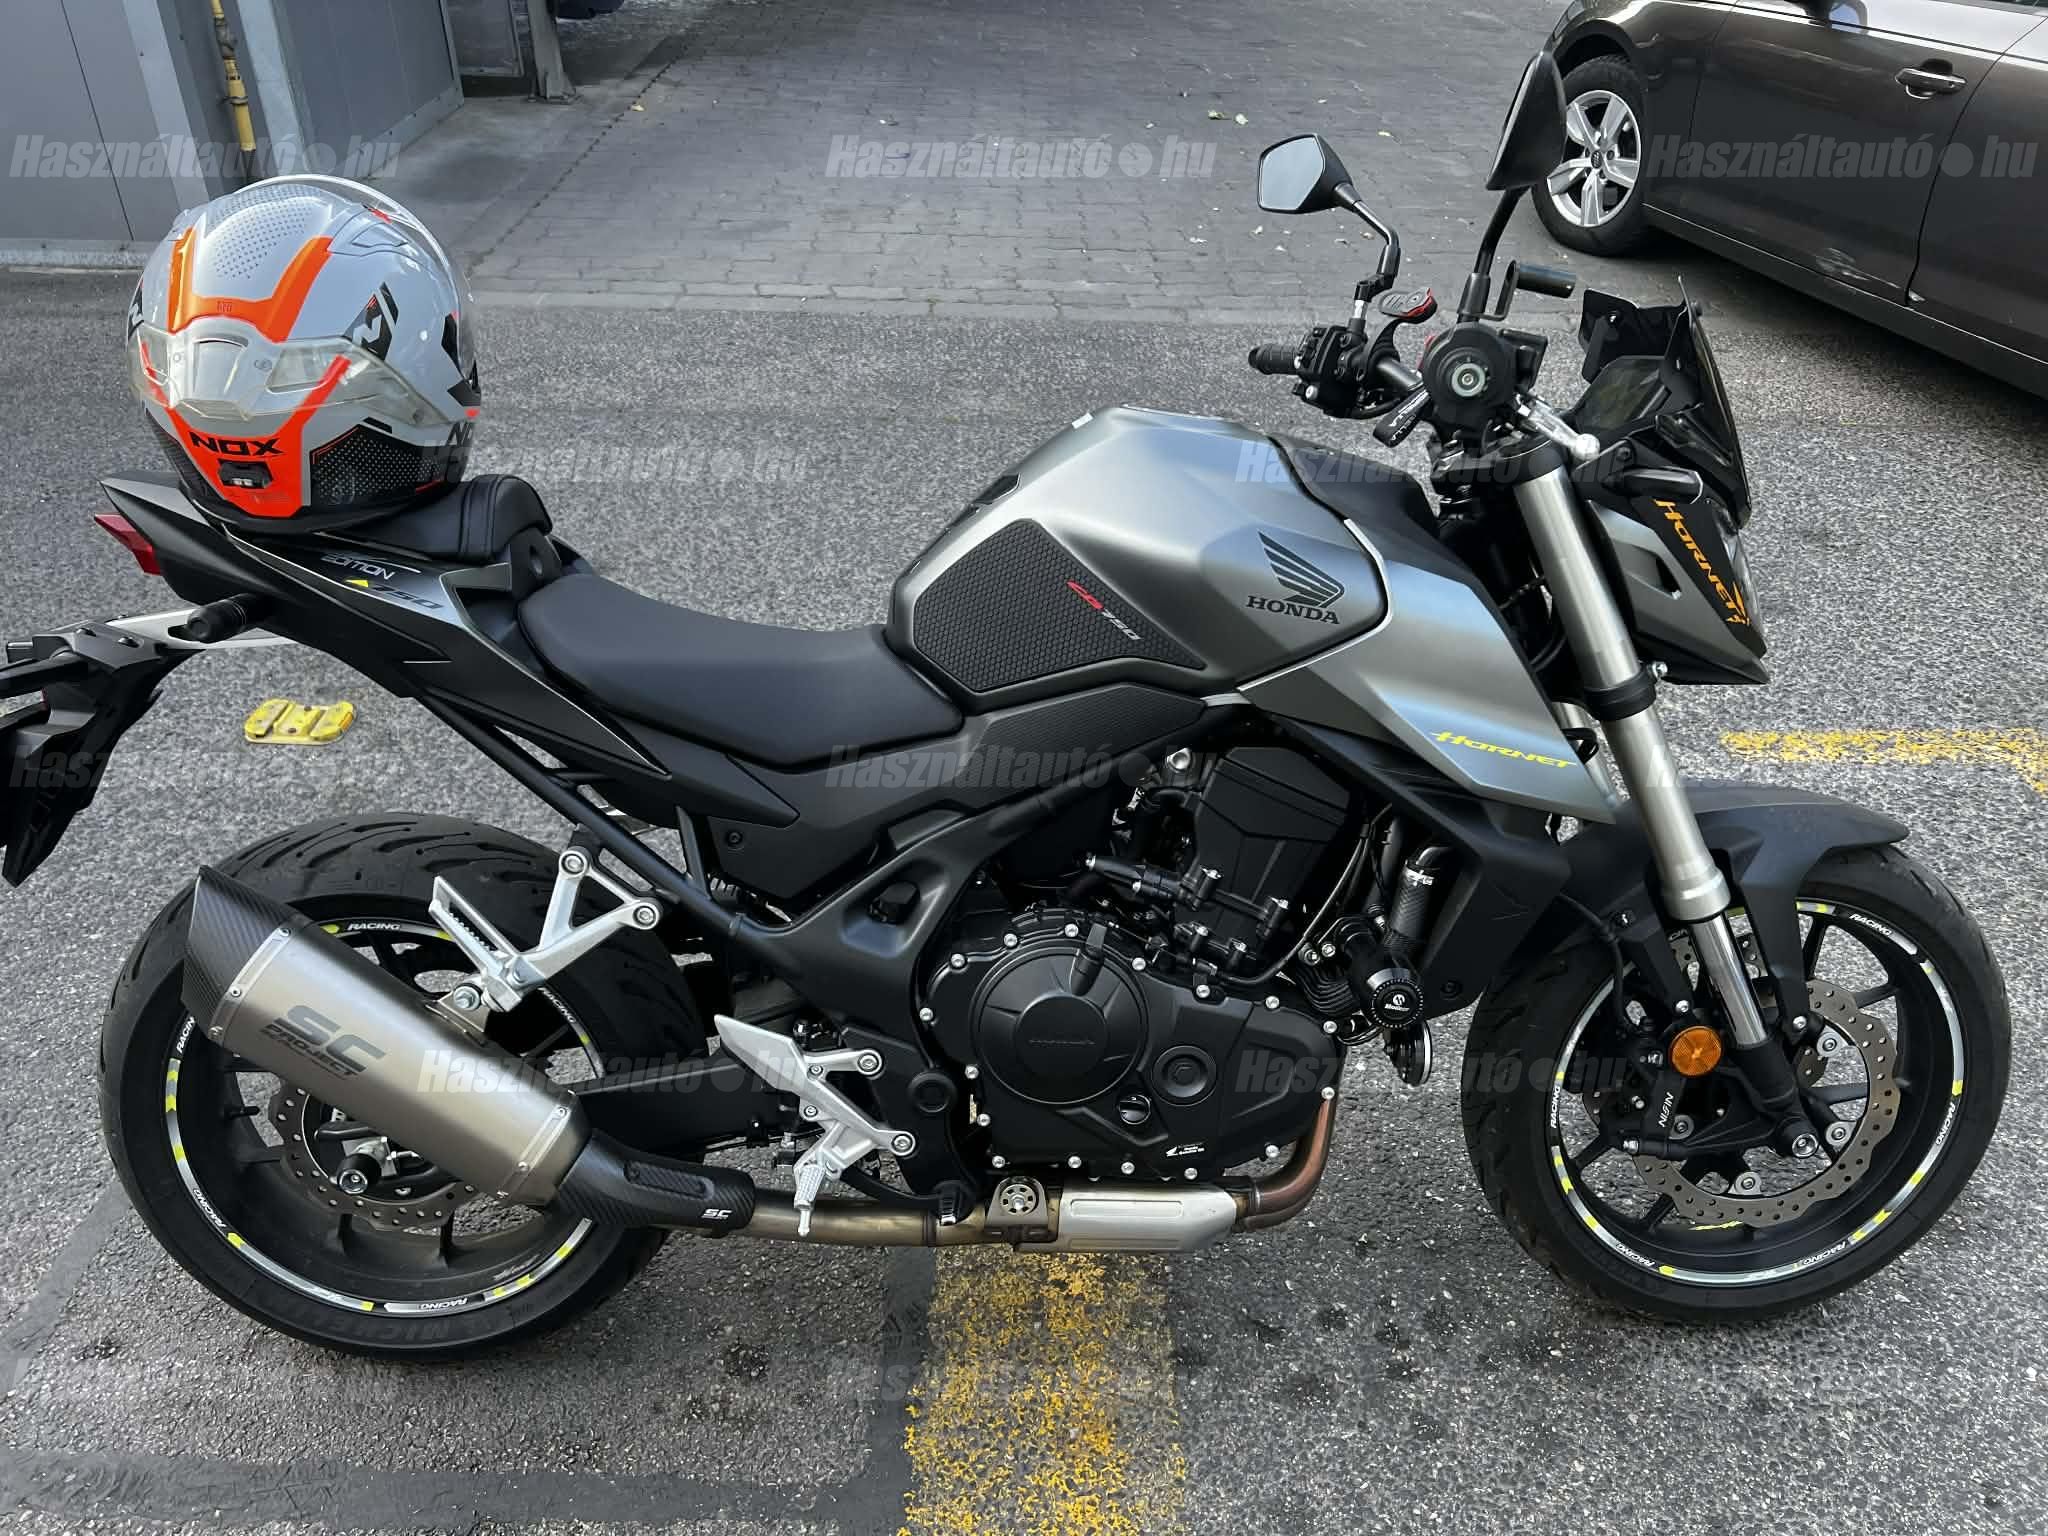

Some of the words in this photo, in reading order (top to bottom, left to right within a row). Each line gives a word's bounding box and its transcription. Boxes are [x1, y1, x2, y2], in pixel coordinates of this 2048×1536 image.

[189, 431, 285, 457] NOX
[1652, 499, 1748, 624] HORNET
[1246, 595, 1340, 625] HONDA
[1430, 731, 1578, 768] HORNET
[347, 922, 400, 931] RACING
[1849, 913, 1893, 936] RACING
[537, 987, 577, 1024] RACING
[176, 1016, 196, 1053] RACIN
[259, 1024, 359, 1080] PROJECT
[271, 1005, 386, 1073] SC
[1551, 1086, 1561, 1129] RACING
[1935, 1102, 1956, 1145] RACING
[193, 1188, 228, 1229] RACING
[701, 1208, 732, 1220] SC
[1615, 1242, 1656, 1268] RACING
[1803, 1241, 1848, 1266] RACING
[420, 1297, 469, 1311] RACING
